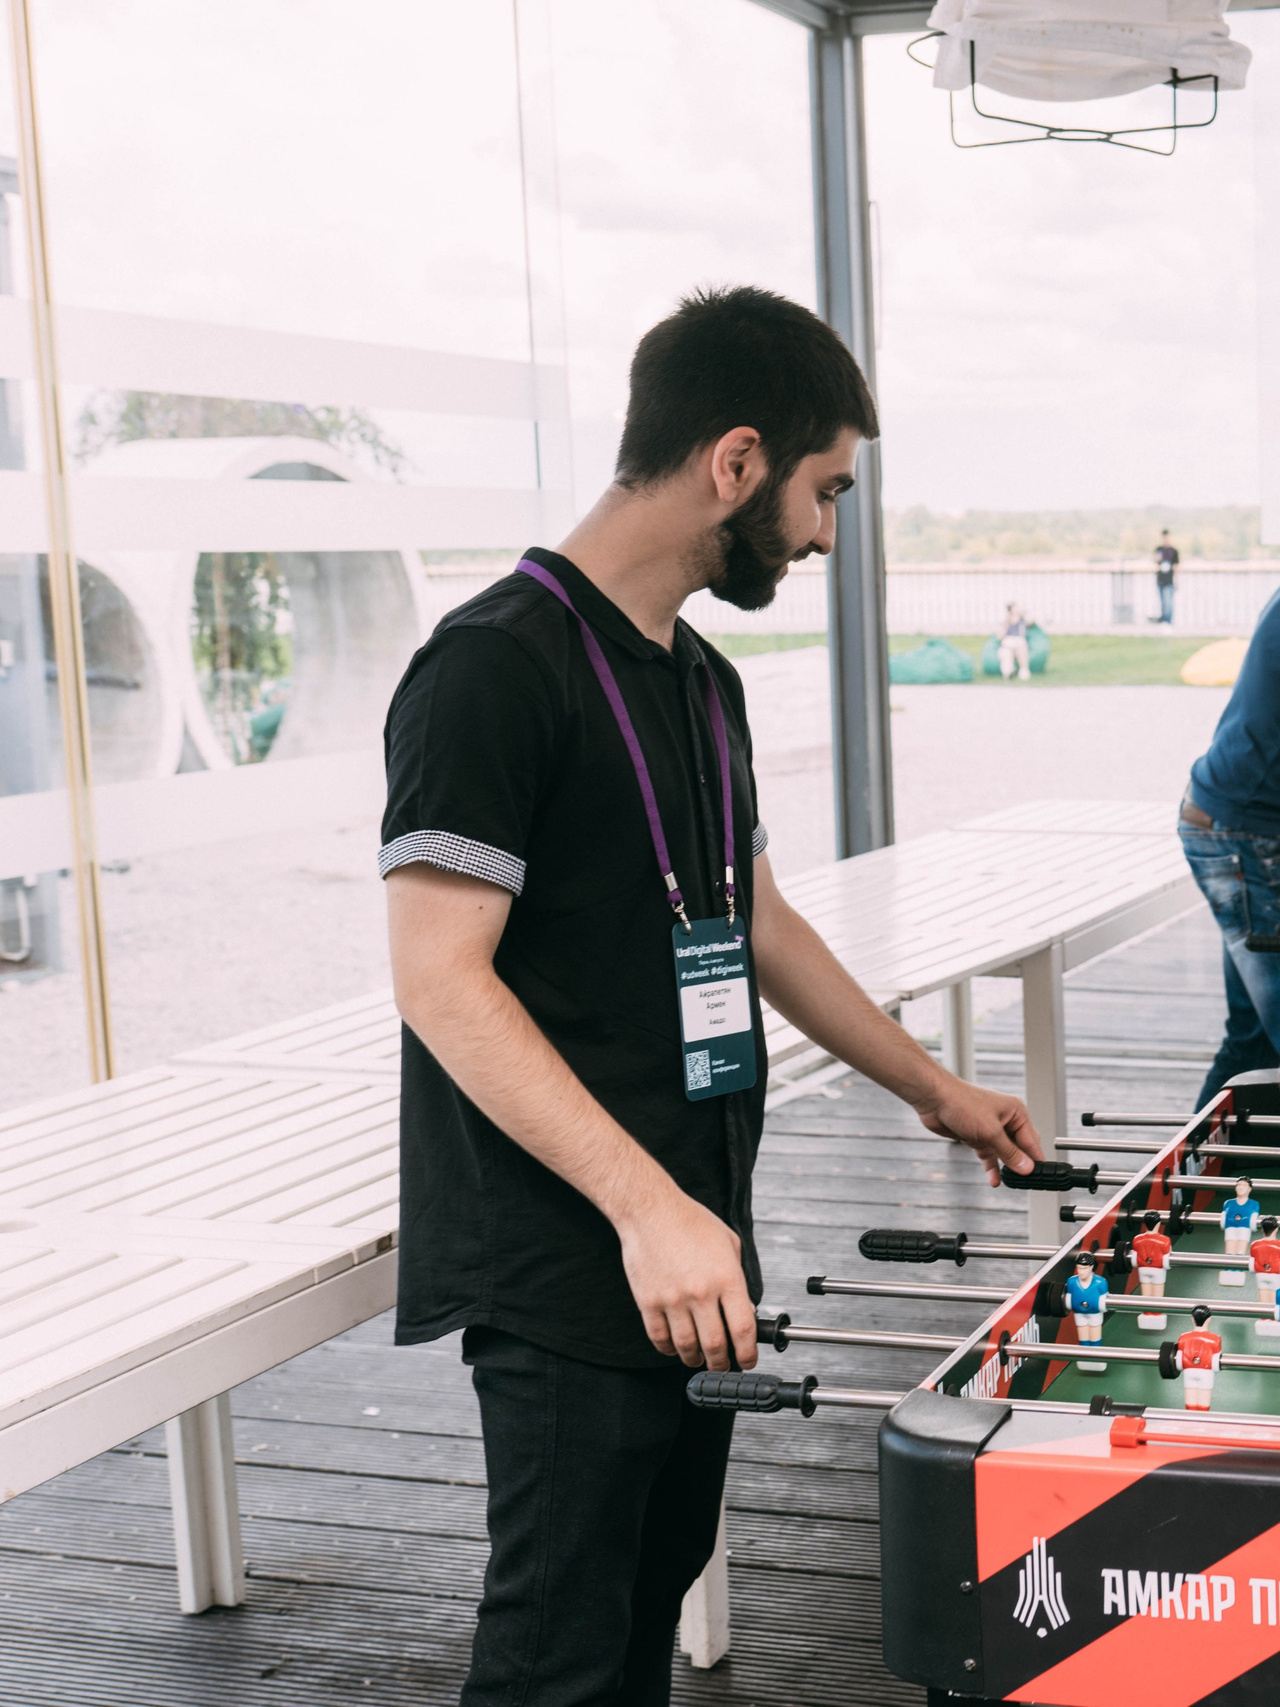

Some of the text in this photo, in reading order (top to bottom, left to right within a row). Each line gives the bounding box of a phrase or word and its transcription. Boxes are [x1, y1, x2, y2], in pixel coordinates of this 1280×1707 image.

[676, 940, 742, 958] Ural Digital Weekend
[1101, 1568, 1236, 1622] АМКАР
